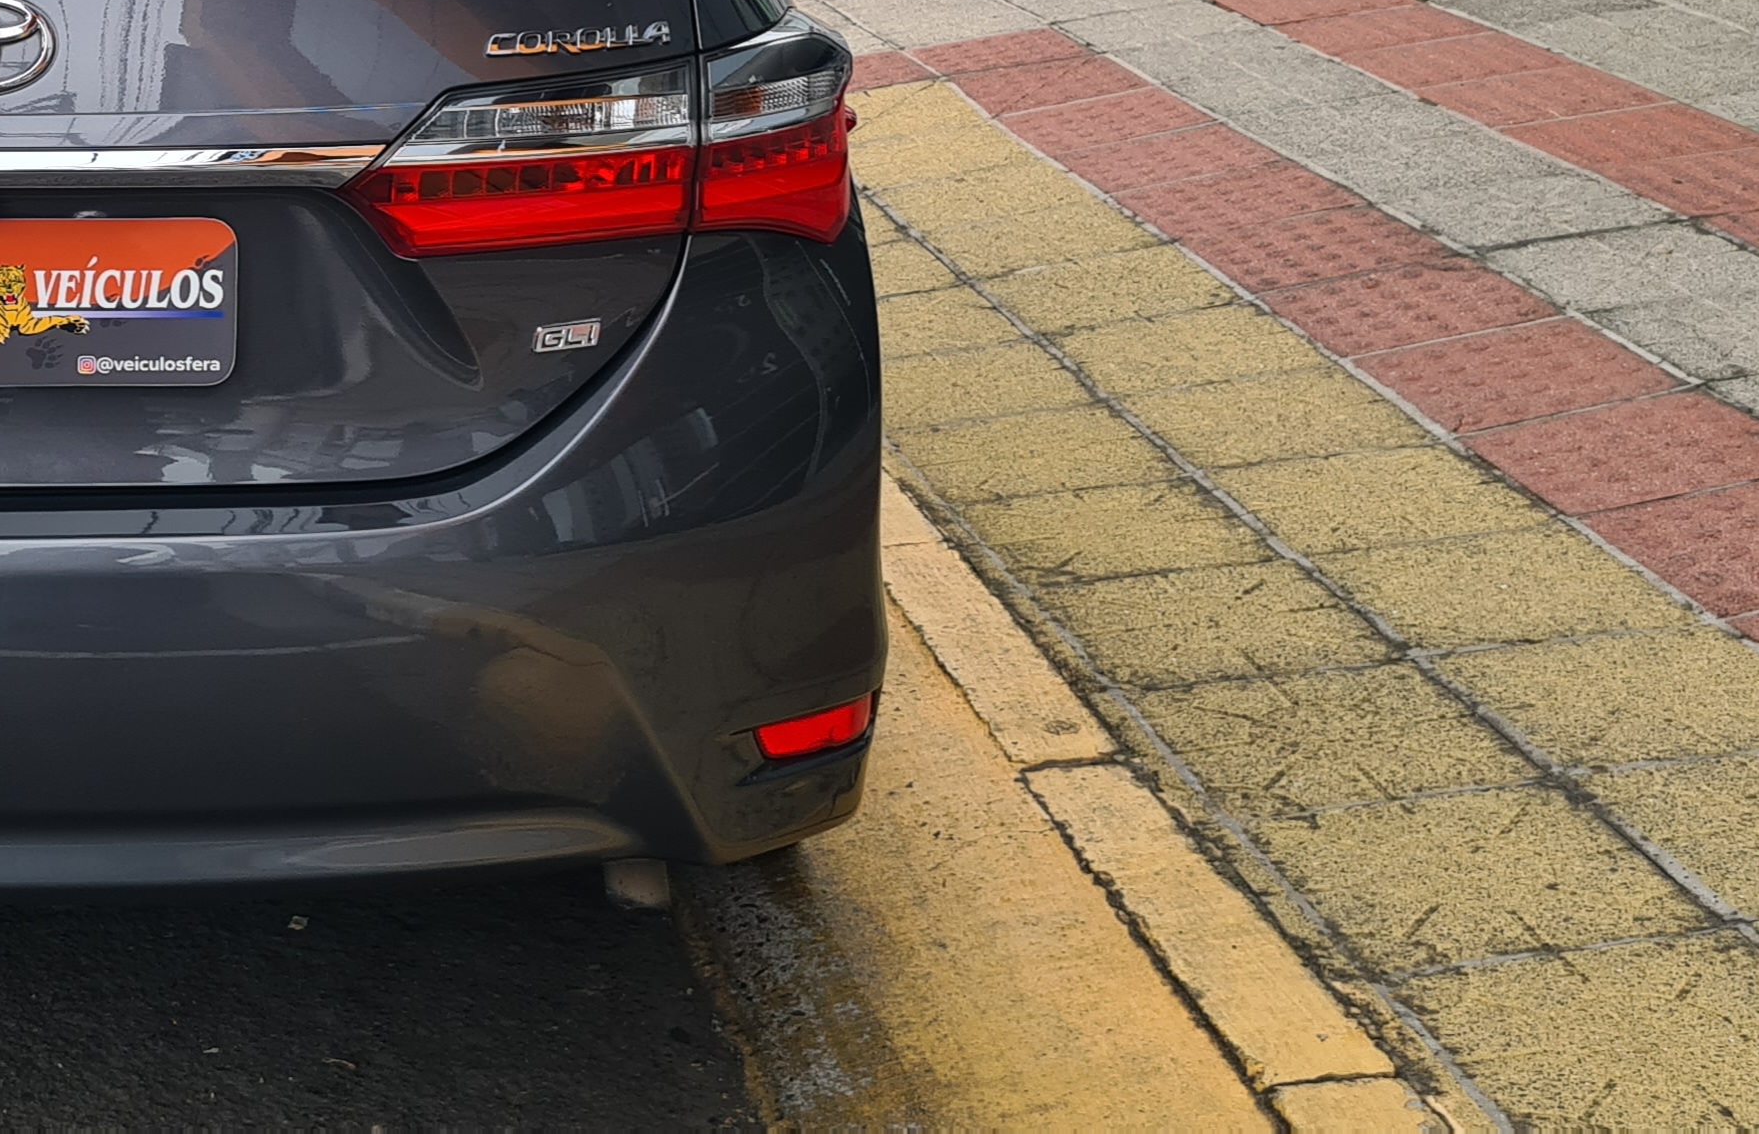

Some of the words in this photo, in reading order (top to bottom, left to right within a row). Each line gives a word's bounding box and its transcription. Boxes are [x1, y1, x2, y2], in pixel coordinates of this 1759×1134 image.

[485, 21, 671, 56] COROLLA
[34, 256, 225, 310] VEÍCULOS
[96, 356, 221, 375] @veiculosfera
